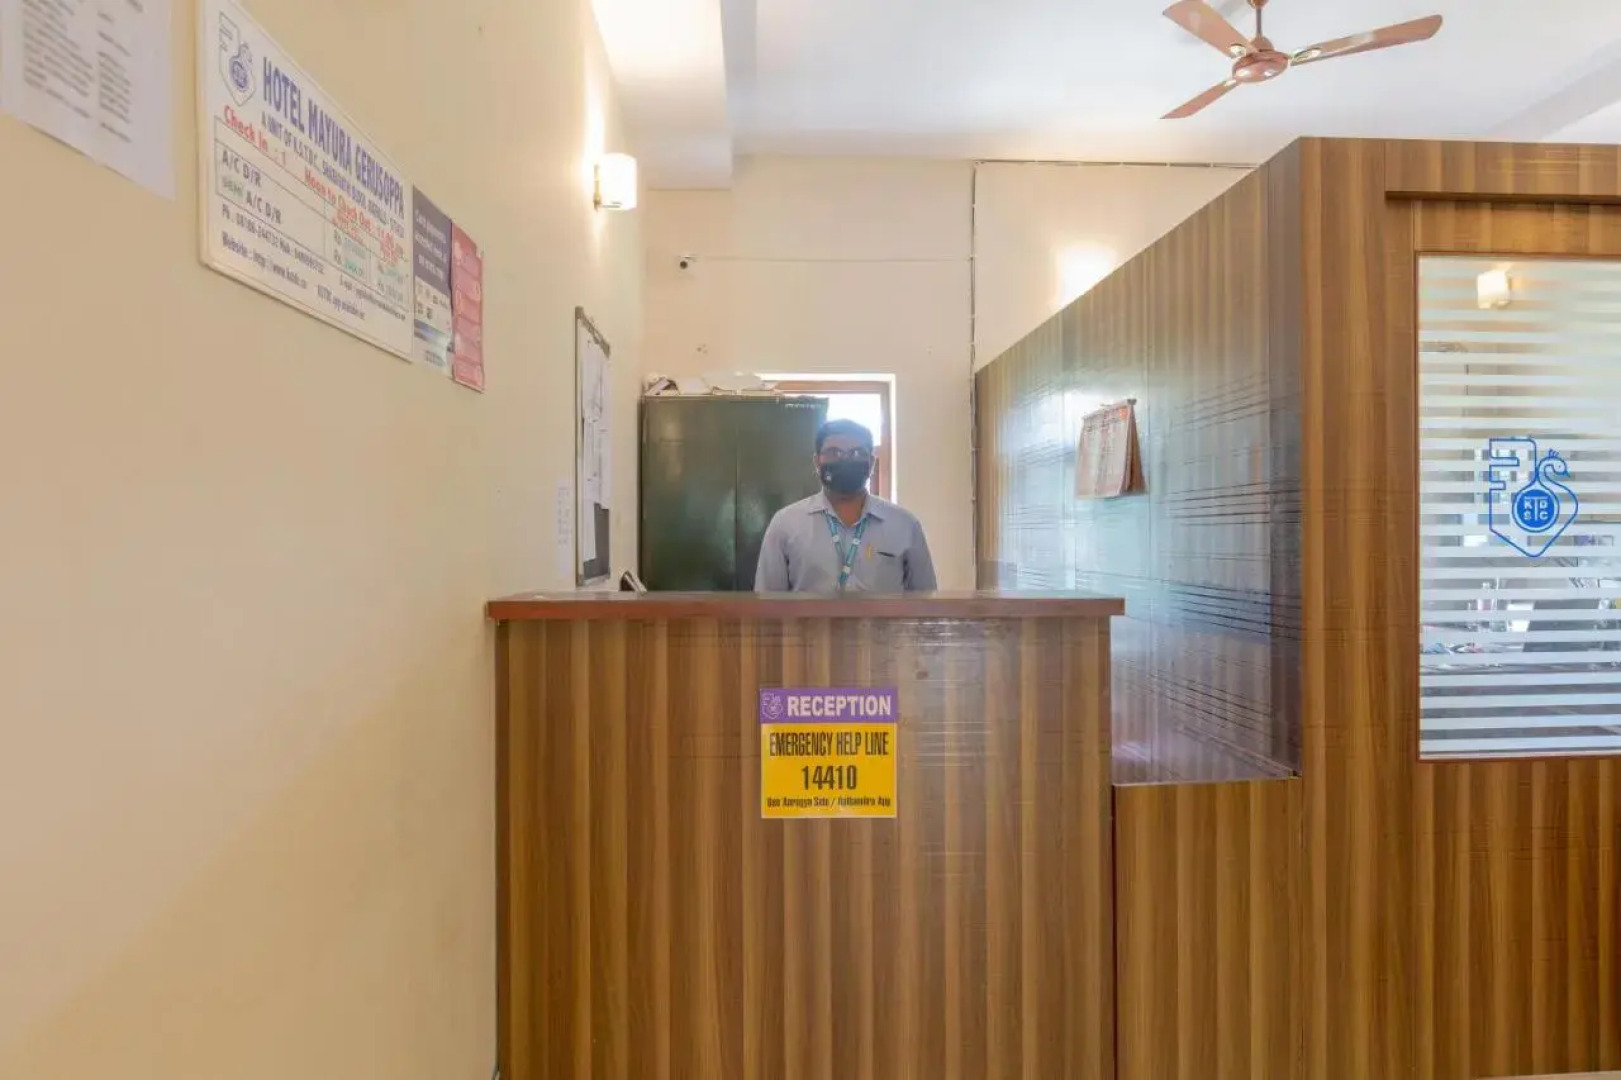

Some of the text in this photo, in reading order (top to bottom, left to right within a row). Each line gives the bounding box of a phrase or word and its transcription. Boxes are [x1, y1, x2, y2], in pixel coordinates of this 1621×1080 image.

[224, 105, 255, 142] Check
[257, 130, 268, 153] In
[263, 56, 305, 133] HOTEL
[308, 98, 352, 173] MAYURA
[355, 143, 405, 220] GERUSOPPA
[222, 149, 241, 173] A/C
[242, 163, 261, 188] D/R
[246, 187, 264, 212] A/C
[265, 202, 282, 224] D/R
[787, 695, 891, 717] RECEPTION
[770, 731, 889, 757] EMERGENCY HELP LINE
[801, 765, 857, 790] 14410
